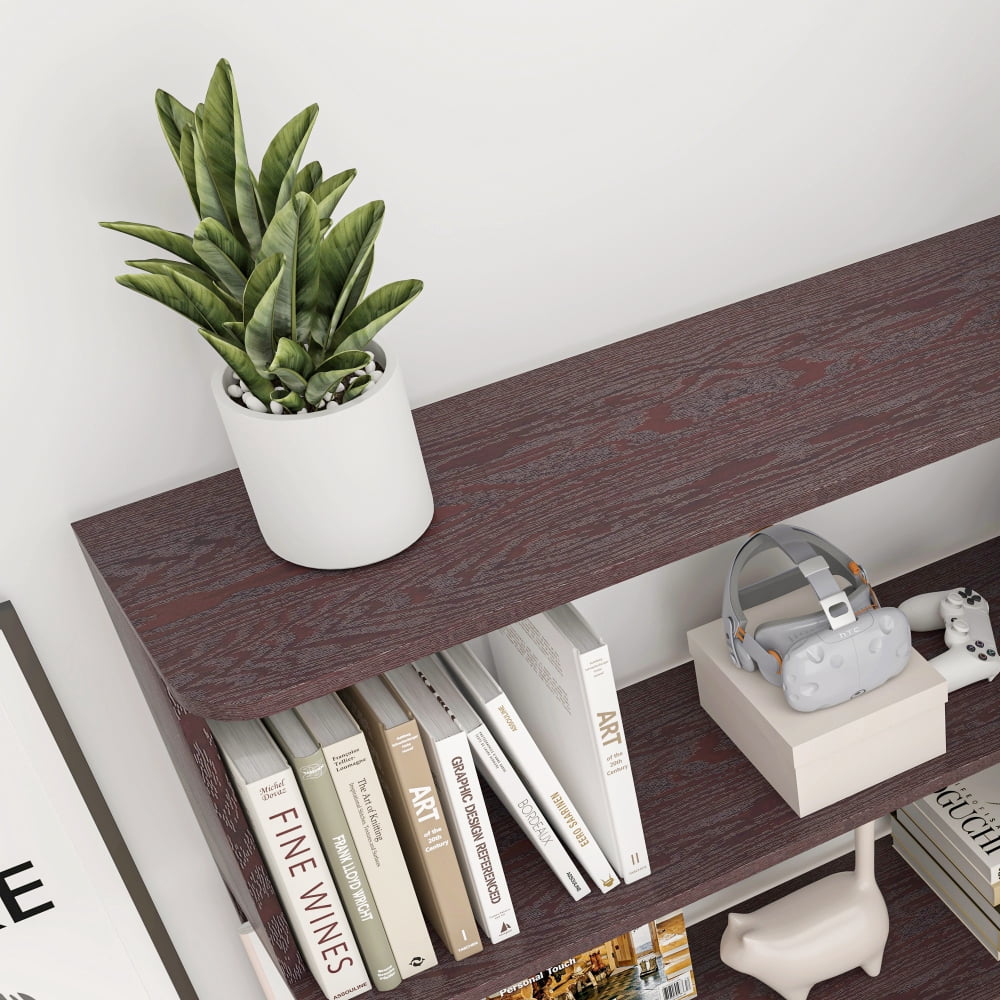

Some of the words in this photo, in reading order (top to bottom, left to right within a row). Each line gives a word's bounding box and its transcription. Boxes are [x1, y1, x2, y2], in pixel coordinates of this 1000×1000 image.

[596, 711, 622, 747] ART
[606, 753, 613, 762] of
[613, 751, 623, 759] the
[609, 759, 623, 768] 20th
[606, 765, 629, 777] Century
[259, 778, 286, 796] Michel
[261, 787, 287, 802] Dovaz
[357, 777, 368, 794] The
[362, 792, 372, 807] Art
[408, 785, 440, 823] ART
[550, 791, 578, 829] SAARINEN
[369, 809, 383, 844] Knitting
[423, 829, 431, 838] of
[431, 826, 442, 835] the
[451, 755, 473, 804] GRAPHIC
[464, 803, 485, 843] DESIGN
[475, 841, 502, 905] REFERENCED
[517, 798, 554, 847] BORDEAUX
[332, 834, 353, 866] FRANK
[424, 839, 449, 853] Century
[428, 835, 442, 844] 20th
[573, 828, 590, 848] EERO
[343, 862, 362, 891] LLOYD
[268, 807, 318, 878] FINE
[300, 881, 354, 975] WINES
[352, 889, 374, 922] WRIGHT
[499, 972, 544, 998] Personal
[548, 957, 577, 977] Touch
